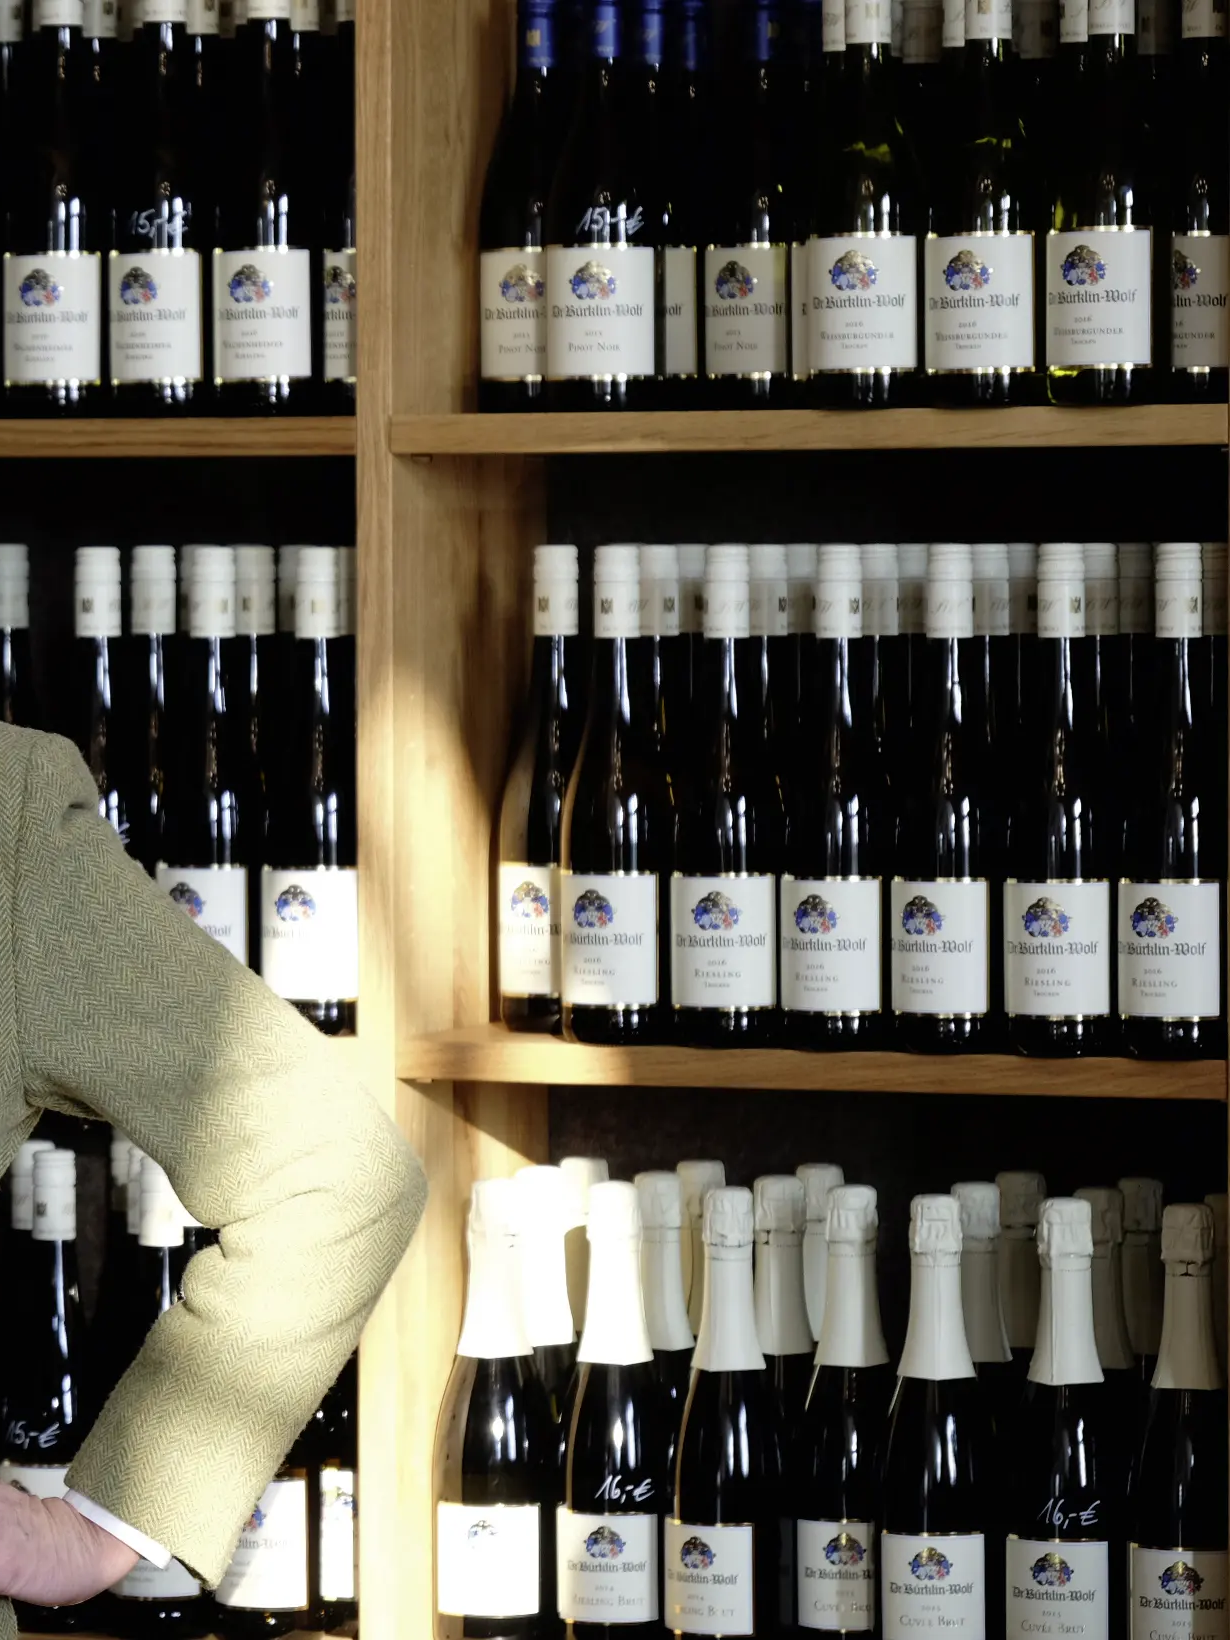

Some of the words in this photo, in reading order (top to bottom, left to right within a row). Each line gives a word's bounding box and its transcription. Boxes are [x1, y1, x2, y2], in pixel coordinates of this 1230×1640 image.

[939, 293, 1021, 310] Bürklin-Wolf
[1058, 288, 1138, 305] Bürklin-Wolf
[1176, 293, 1229, 308] lin-Wolf
[496, 306, 547, 320] Bürklin-
[568, 342, 595, 352] PINOT
[597, 342, 621, 352] NOIR
[687, 932, 768, 948] Bürklin-Wolf
[1017, 940, 1100, 956] Bürklin-Wolf
[1126, 941, 1208, 957] Bürklin-Wolf
[694, 968, 742, 979] RIESLING
[1024, 976, 1071, 987] RIESLING
[1131, 977, 1178, 988] RIESLING
[5, 1420, 62, 1450] 15,-€
[594, 1474, 655, 1505] 16,-€
[1036, 1497, 1101, 1530] 16,-€
[817, 1567, 872, 1581] Bürklin-W
[1025, 1587, 1097, 1603] Bürklin-Wolf
[1139, 1595, 1152, 1608] Dr
[1152, 1596, 1226, 1611] Bürklin-Wolf
